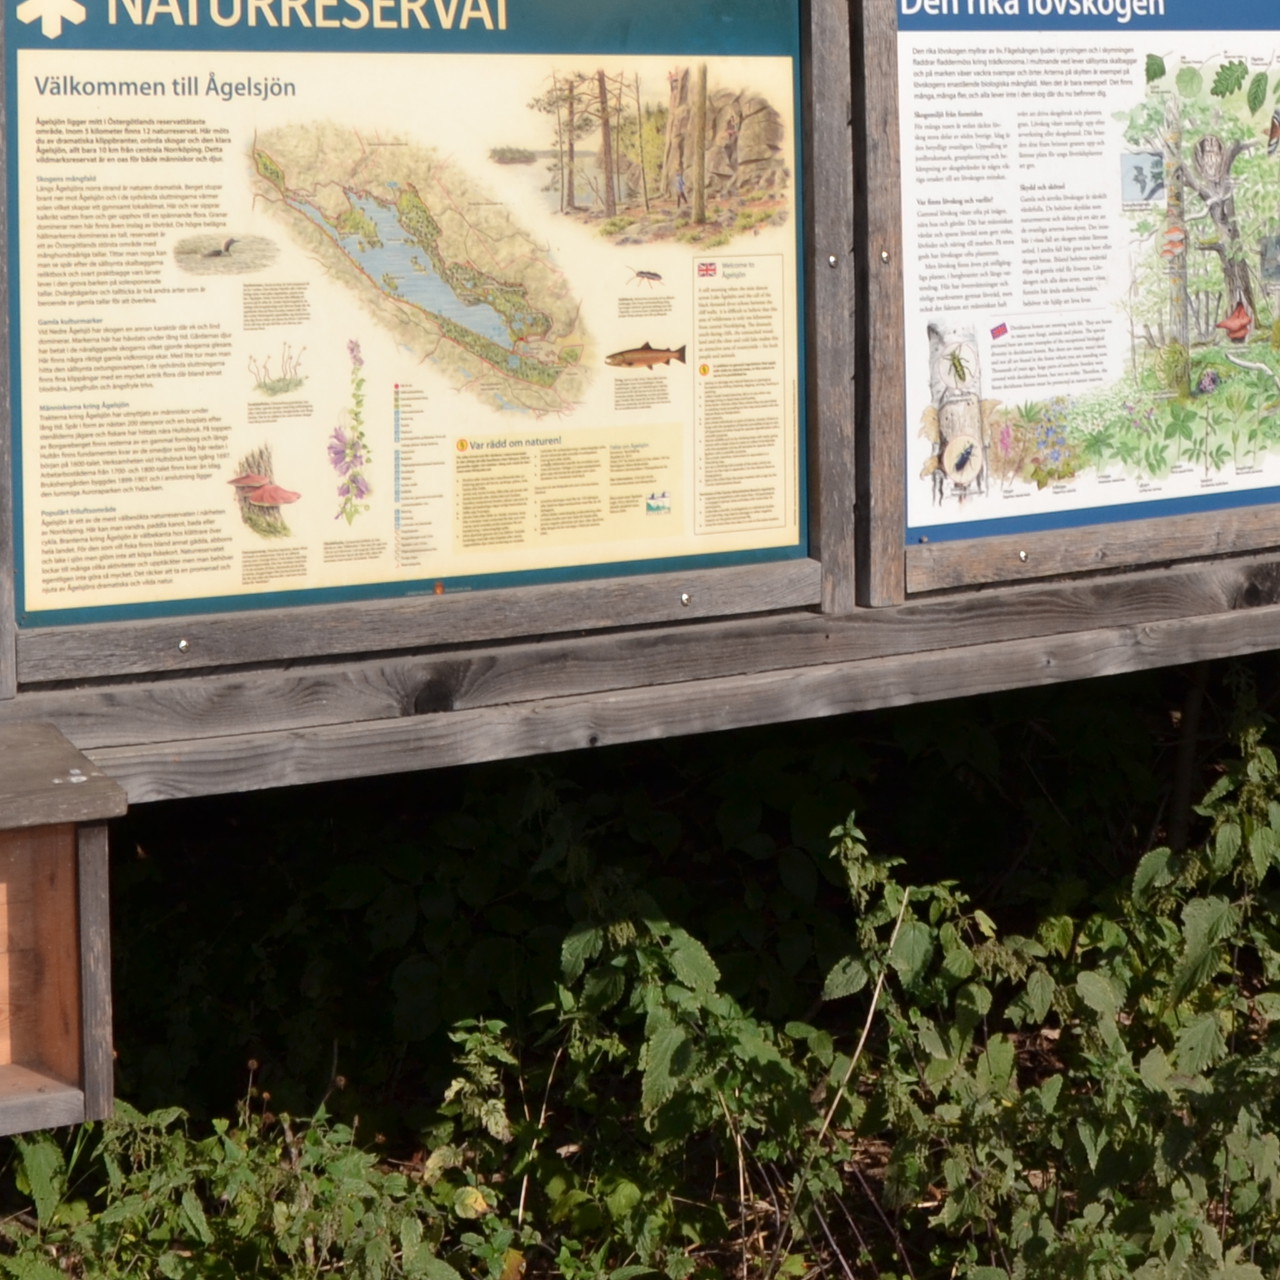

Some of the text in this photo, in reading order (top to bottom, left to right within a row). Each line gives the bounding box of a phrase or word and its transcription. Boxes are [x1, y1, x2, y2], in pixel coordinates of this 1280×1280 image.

[34, 72, 297, 102] Välkommen till Ågelsjön
[469, 436, 562, 451] Var rädd om naturen!
